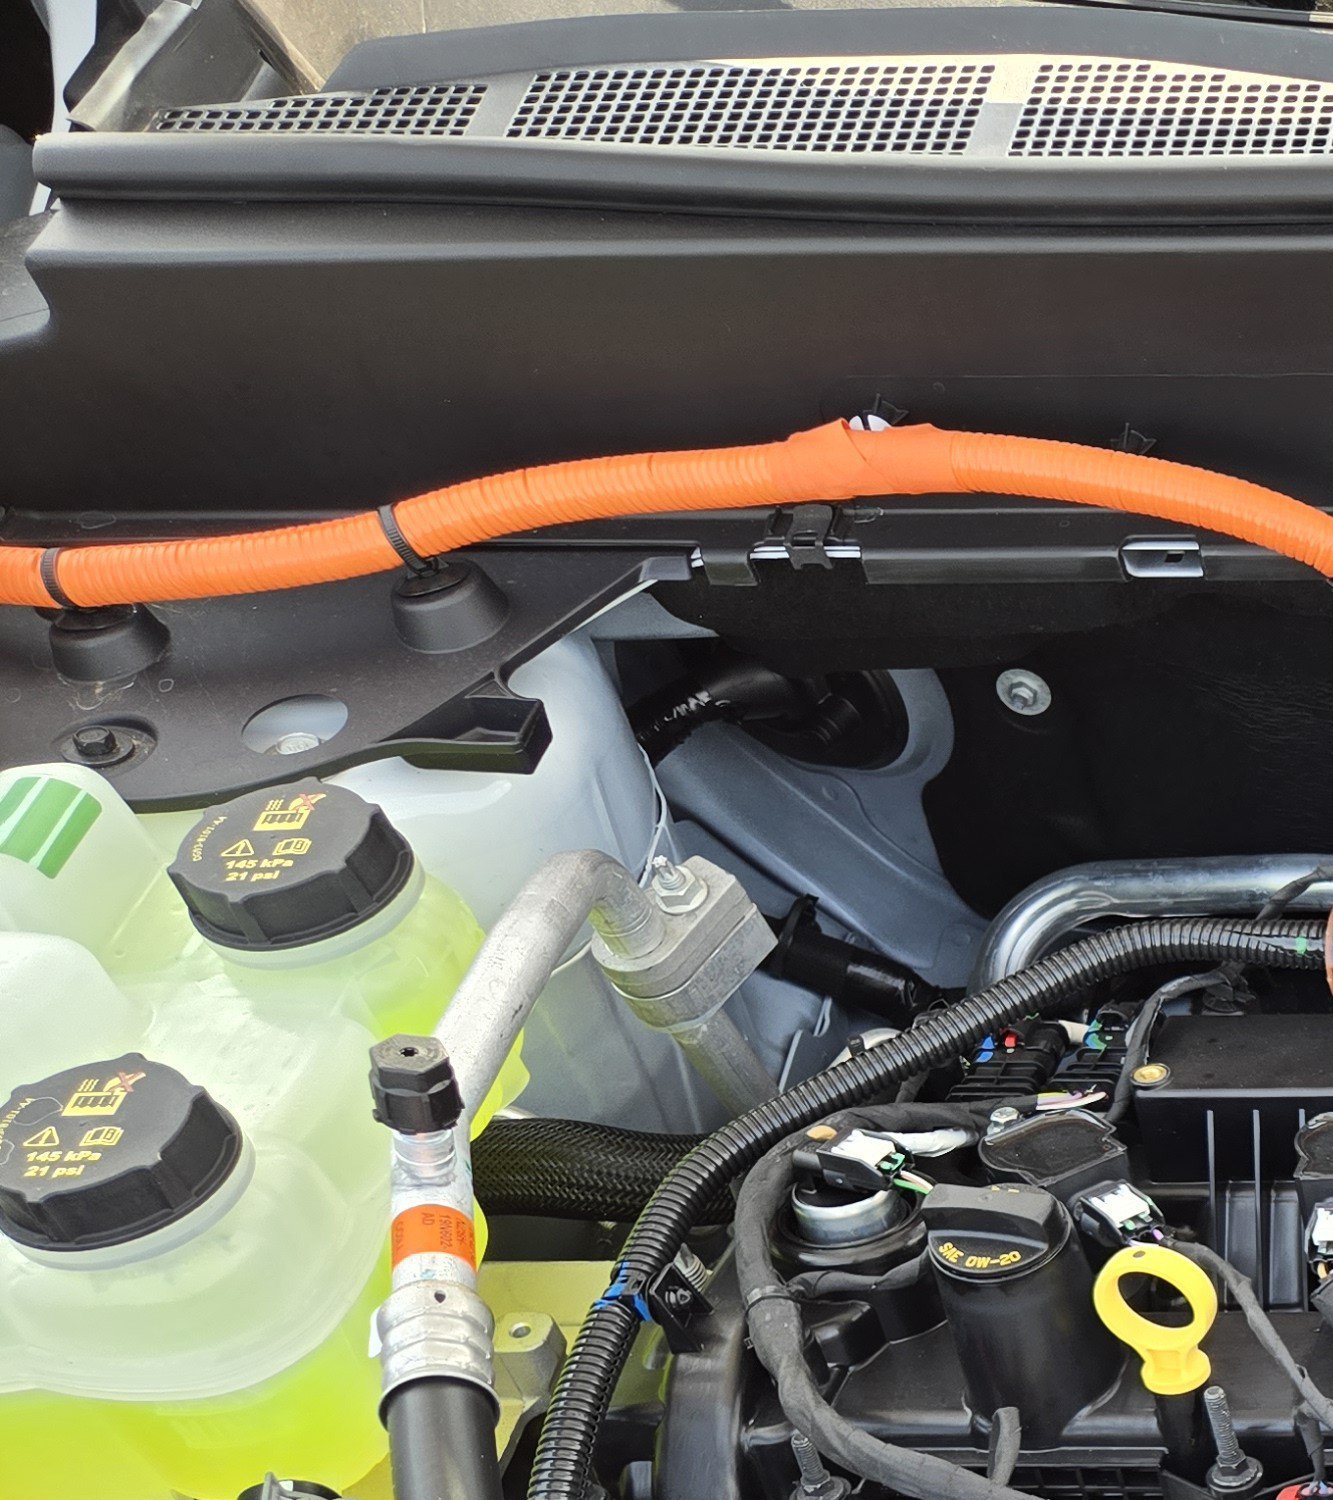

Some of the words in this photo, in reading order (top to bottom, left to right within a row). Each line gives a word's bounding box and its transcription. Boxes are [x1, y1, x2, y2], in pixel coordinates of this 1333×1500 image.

[225, 858, 258, 869] 145
[260, 858, 294, 868] kPa
[225, 871, 248, 882] 21
[251, 870, 280, 882] psi
[26, 1151, 62, 1161] 145
[64, 1150, 102, 1161] kPa
[24, 1165, 50, 1177] 21
[52, 1164, 85, 1178] psi
[938, 1242, 965, 1263] SAE
